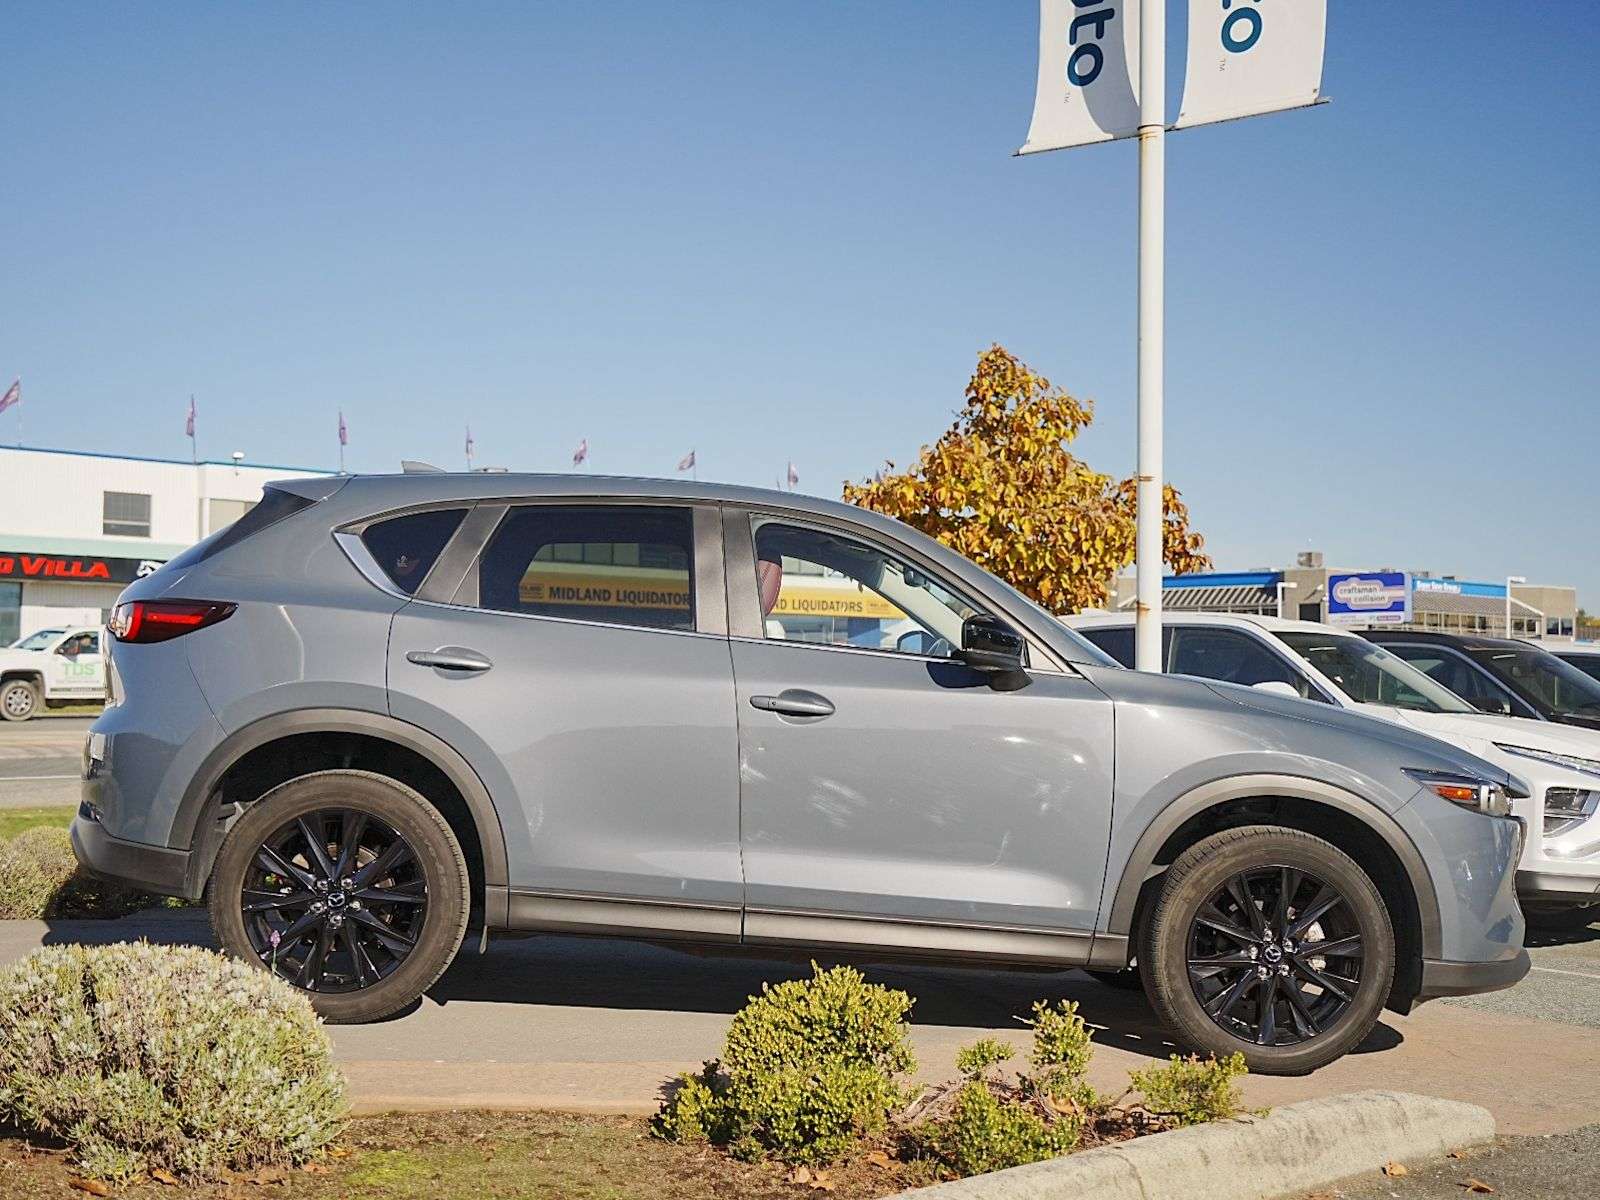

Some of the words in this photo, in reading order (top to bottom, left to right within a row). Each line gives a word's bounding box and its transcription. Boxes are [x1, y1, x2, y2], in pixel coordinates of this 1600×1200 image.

[20, 555, 110, 578] VILLA
[549, 587, 611, 602] MIDLAND
[793, 599, 863, 613] LIQUIDATORS
